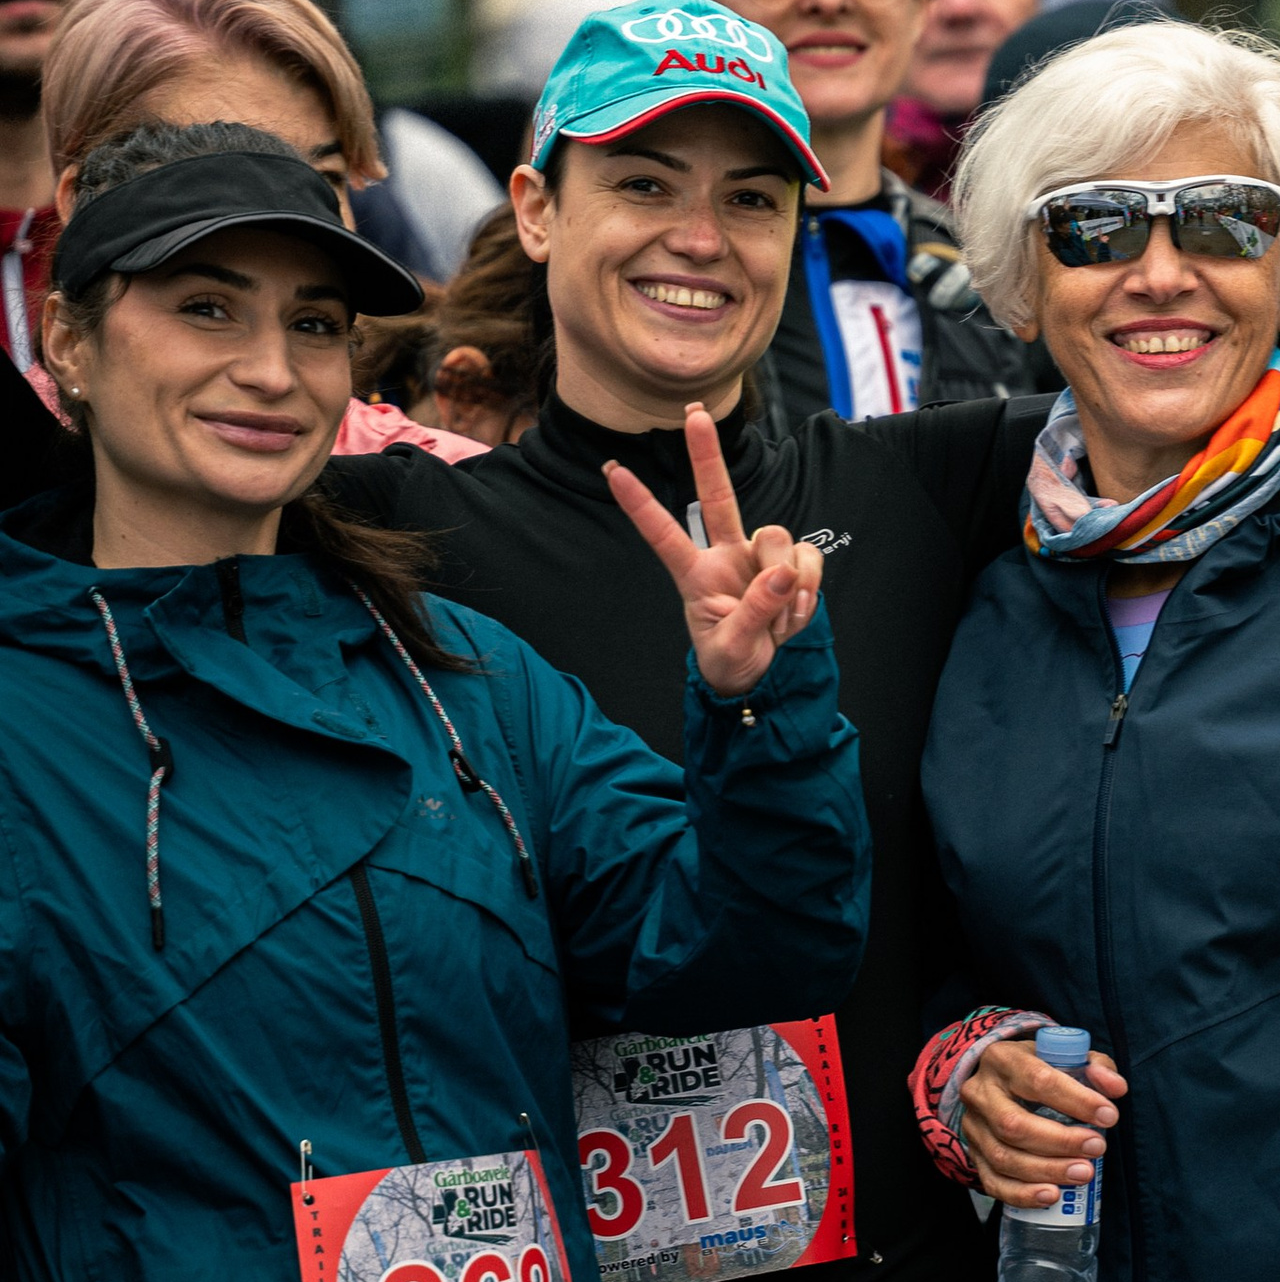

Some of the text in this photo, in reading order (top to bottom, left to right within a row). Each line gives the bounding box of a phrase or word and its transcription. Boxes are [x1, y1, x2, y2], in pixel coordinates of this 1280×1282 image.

[652, 49, 767, 91] Audi
[820, 532, 853, 555] enji
[646, 1043, 717, 1074] RUN
[639, 1066, 656, 1085] &
[652, 1066, 722, 1098] RIDE
[434, 1164, 510, 1188] Gârboavele
[577, 1100, 806, 1242] 312
[463, 1182, 514, 1208] RUN
[456, 1199, 471, 1218] &
[467, 1206, 517, 1233] RIDE
[700, 1225, 767, 1249] maus
[600, 1250, 680, 1274] owered by
